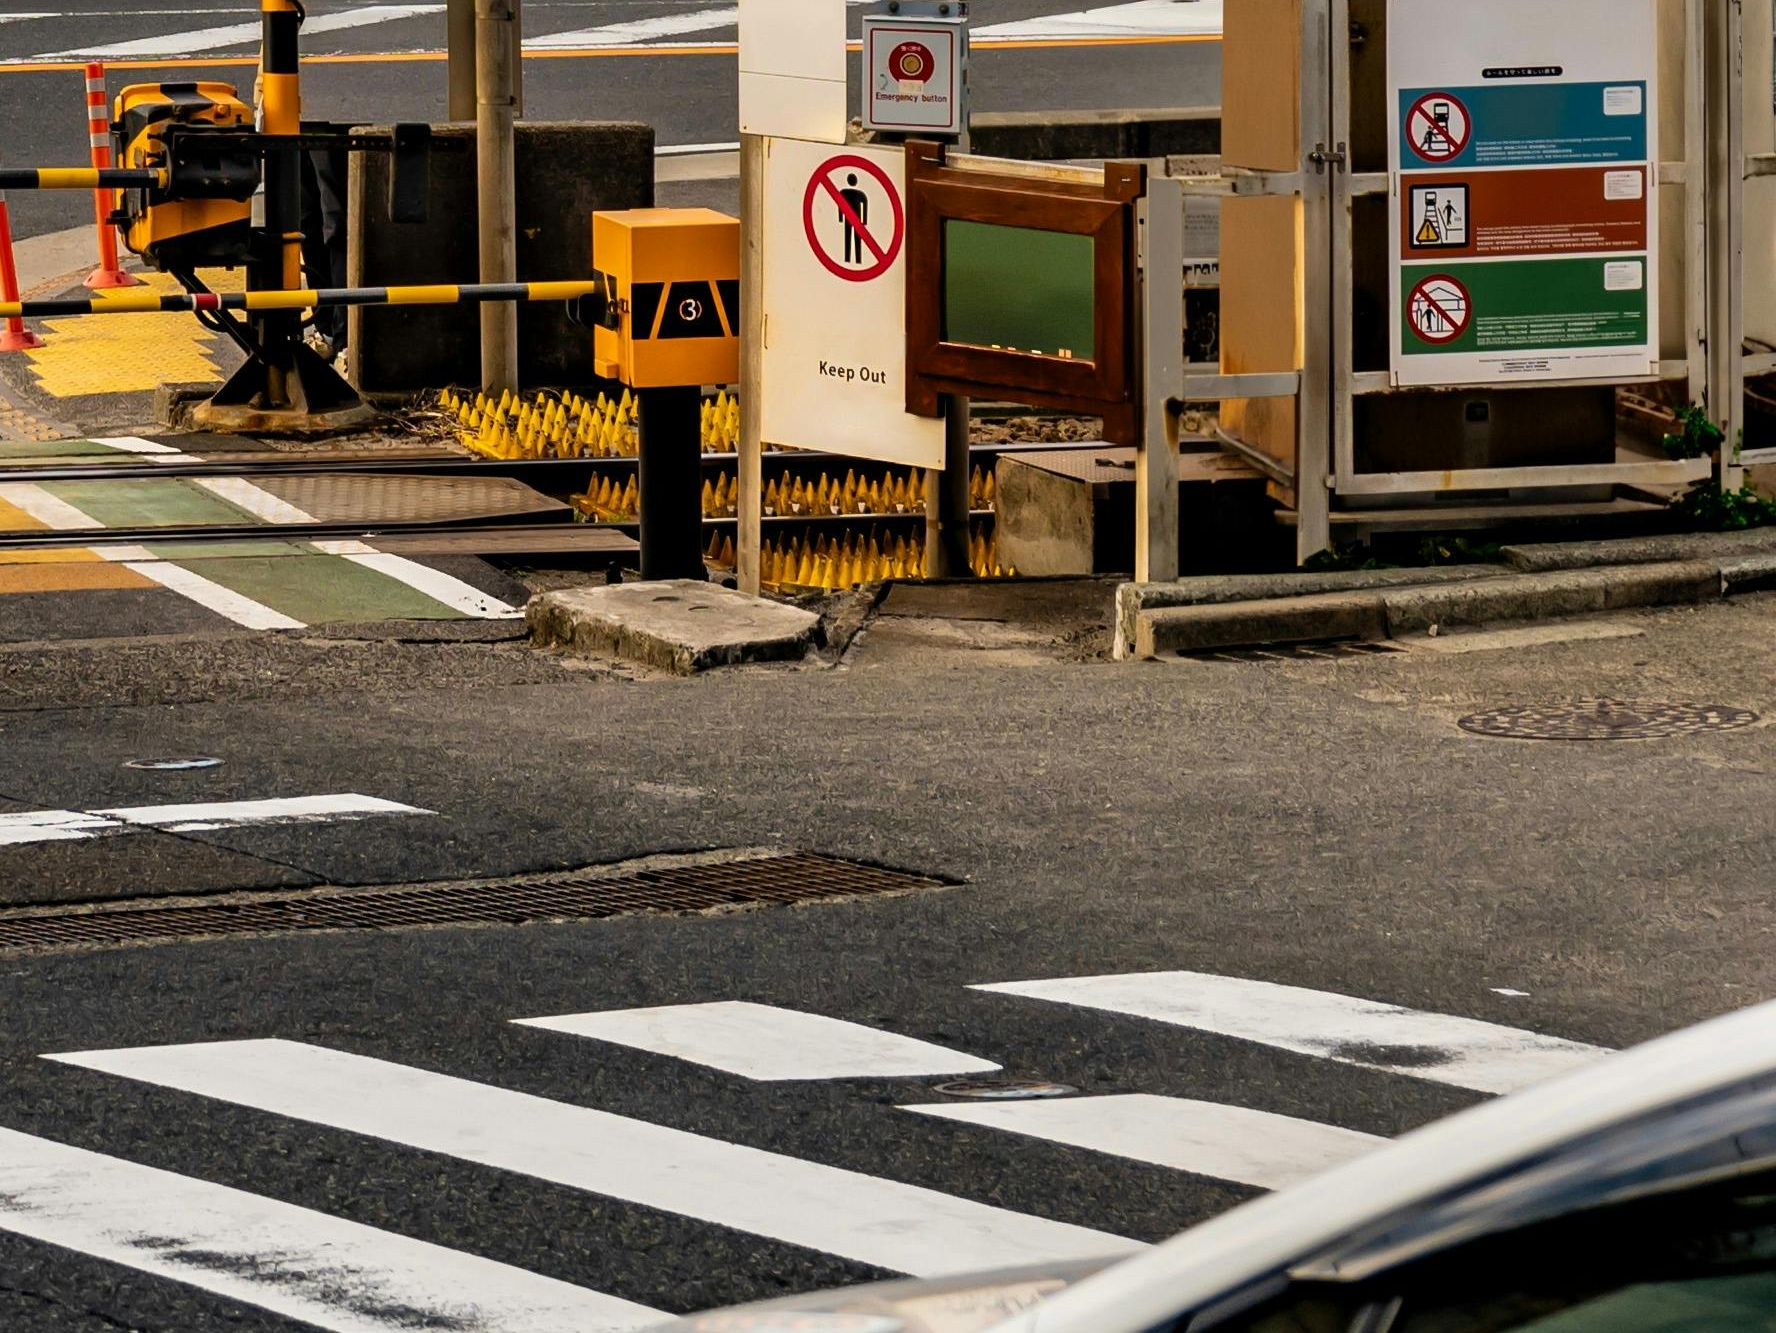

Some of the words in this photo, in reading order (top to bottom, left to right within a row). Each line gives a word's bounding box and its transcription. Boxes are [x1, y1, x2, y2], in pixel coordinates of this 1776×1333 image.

[875, 92, 918, 103] Emergency
[922, 94, 947, 103] button
[819, 360, 855, 382] Keep
[859, 366, 886, 384] Out
